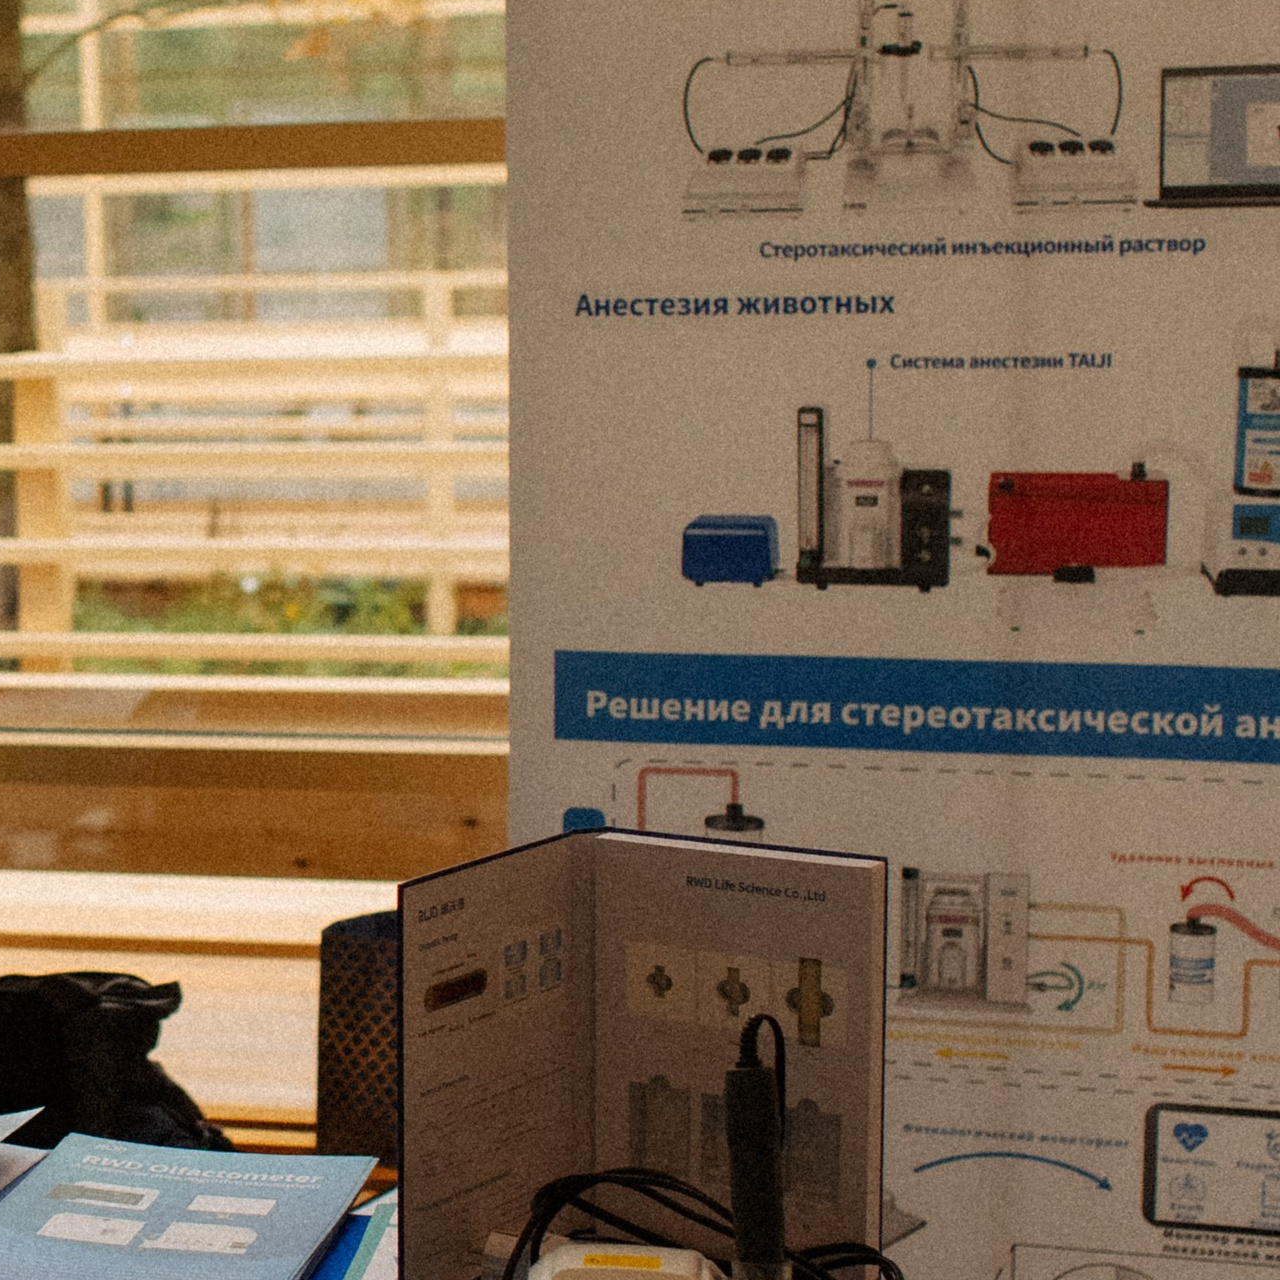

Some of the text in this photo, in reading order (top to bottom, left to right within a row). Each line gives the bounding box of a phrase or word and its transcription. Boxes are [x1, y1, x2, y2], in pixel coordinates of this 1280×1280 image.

[952, 235, 1114, 257] инъекционный
[1119, 234, 1206, 257] раствор
[574, 292, 895, 318] Анестезия животных
[890, 354, 965, 369] Система
[969, 354, 1064, 369] анестезии
[585, 690, 752, 724] Решение
[760, 694, 833, 729] для
[839, 697, 1223, 738] стереотаксической
[686, 876, 712, 888] RWD
[715, 879, 735, 891] Life
[738, 882, 782, 896] Science
[81, 1153, 144, 1173] RWD
[148, 1161, 326, 1186] Olfactometer
